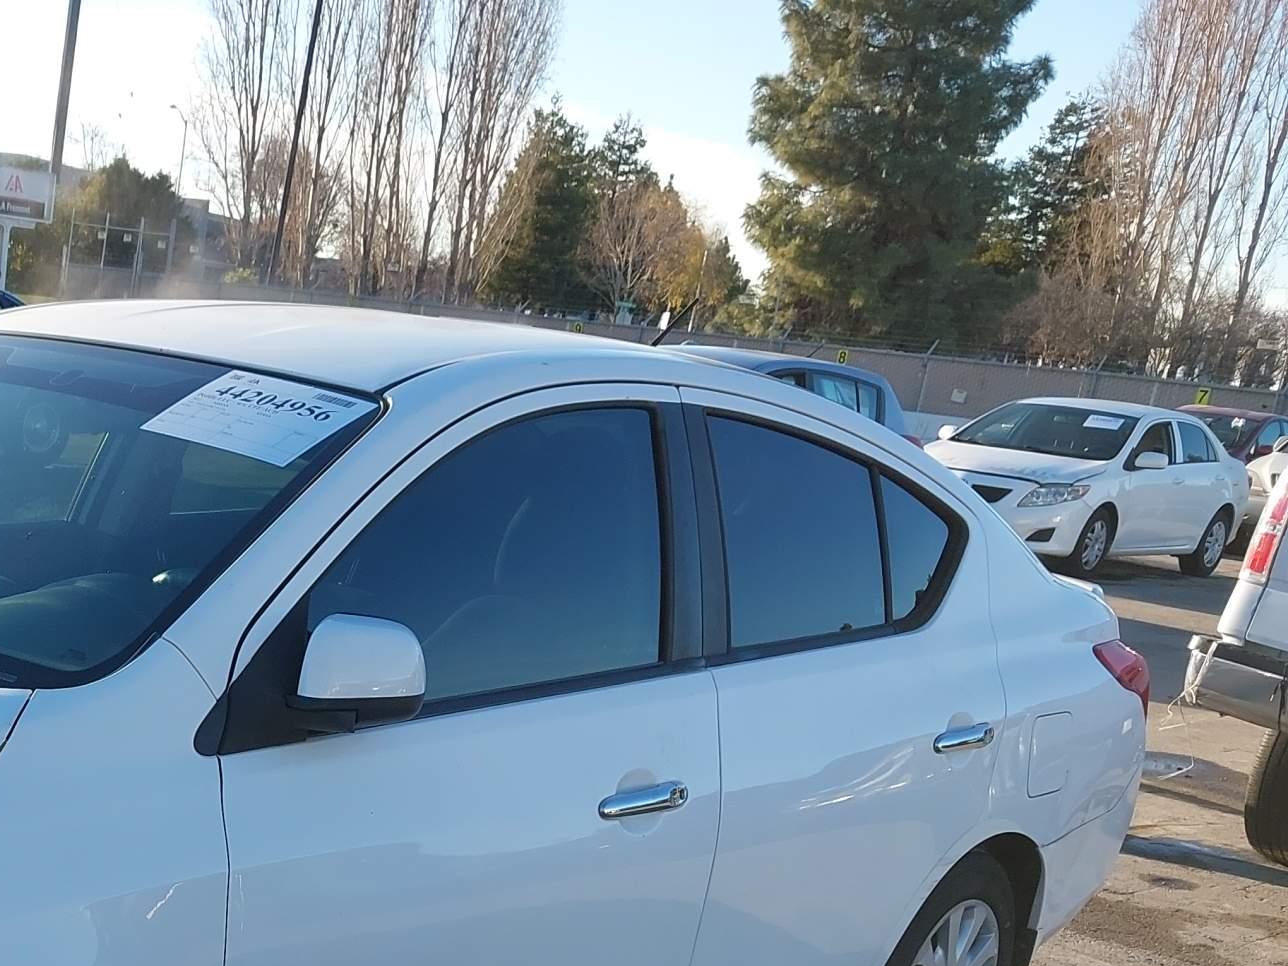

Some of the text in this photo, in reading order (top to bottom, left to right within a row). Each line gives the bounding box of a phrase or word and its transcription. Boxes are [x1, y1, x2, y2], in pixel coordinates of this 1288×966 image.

[838, 351, 847, 364] 8
[215, 385, 337, 422] 44204956
[1198, 389, 1209, 404] 7
